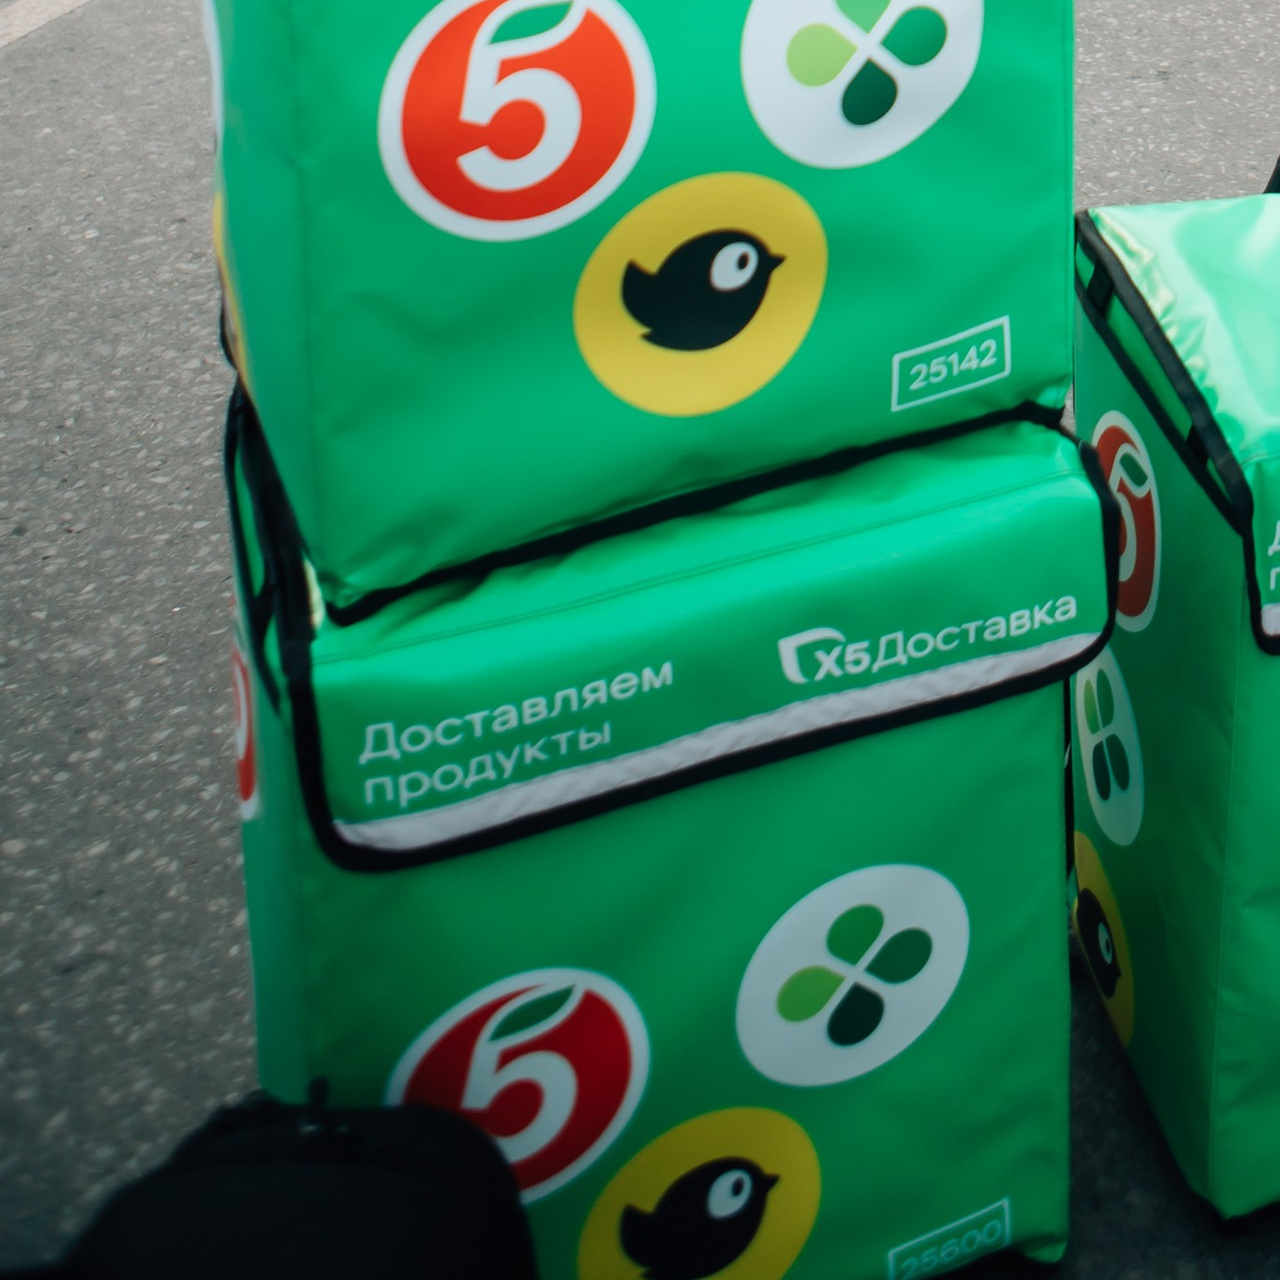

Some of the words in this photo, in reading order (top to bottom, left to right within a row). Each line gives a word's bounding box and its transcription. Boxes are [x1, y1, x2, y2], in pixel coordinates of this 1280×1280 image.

[909, 338, 998, 392] 25142
[359, 660, 674, 766] Доставляем
[364, 721, 612, 808] продукты
[899, 1219, 1001, 1280] 25600
